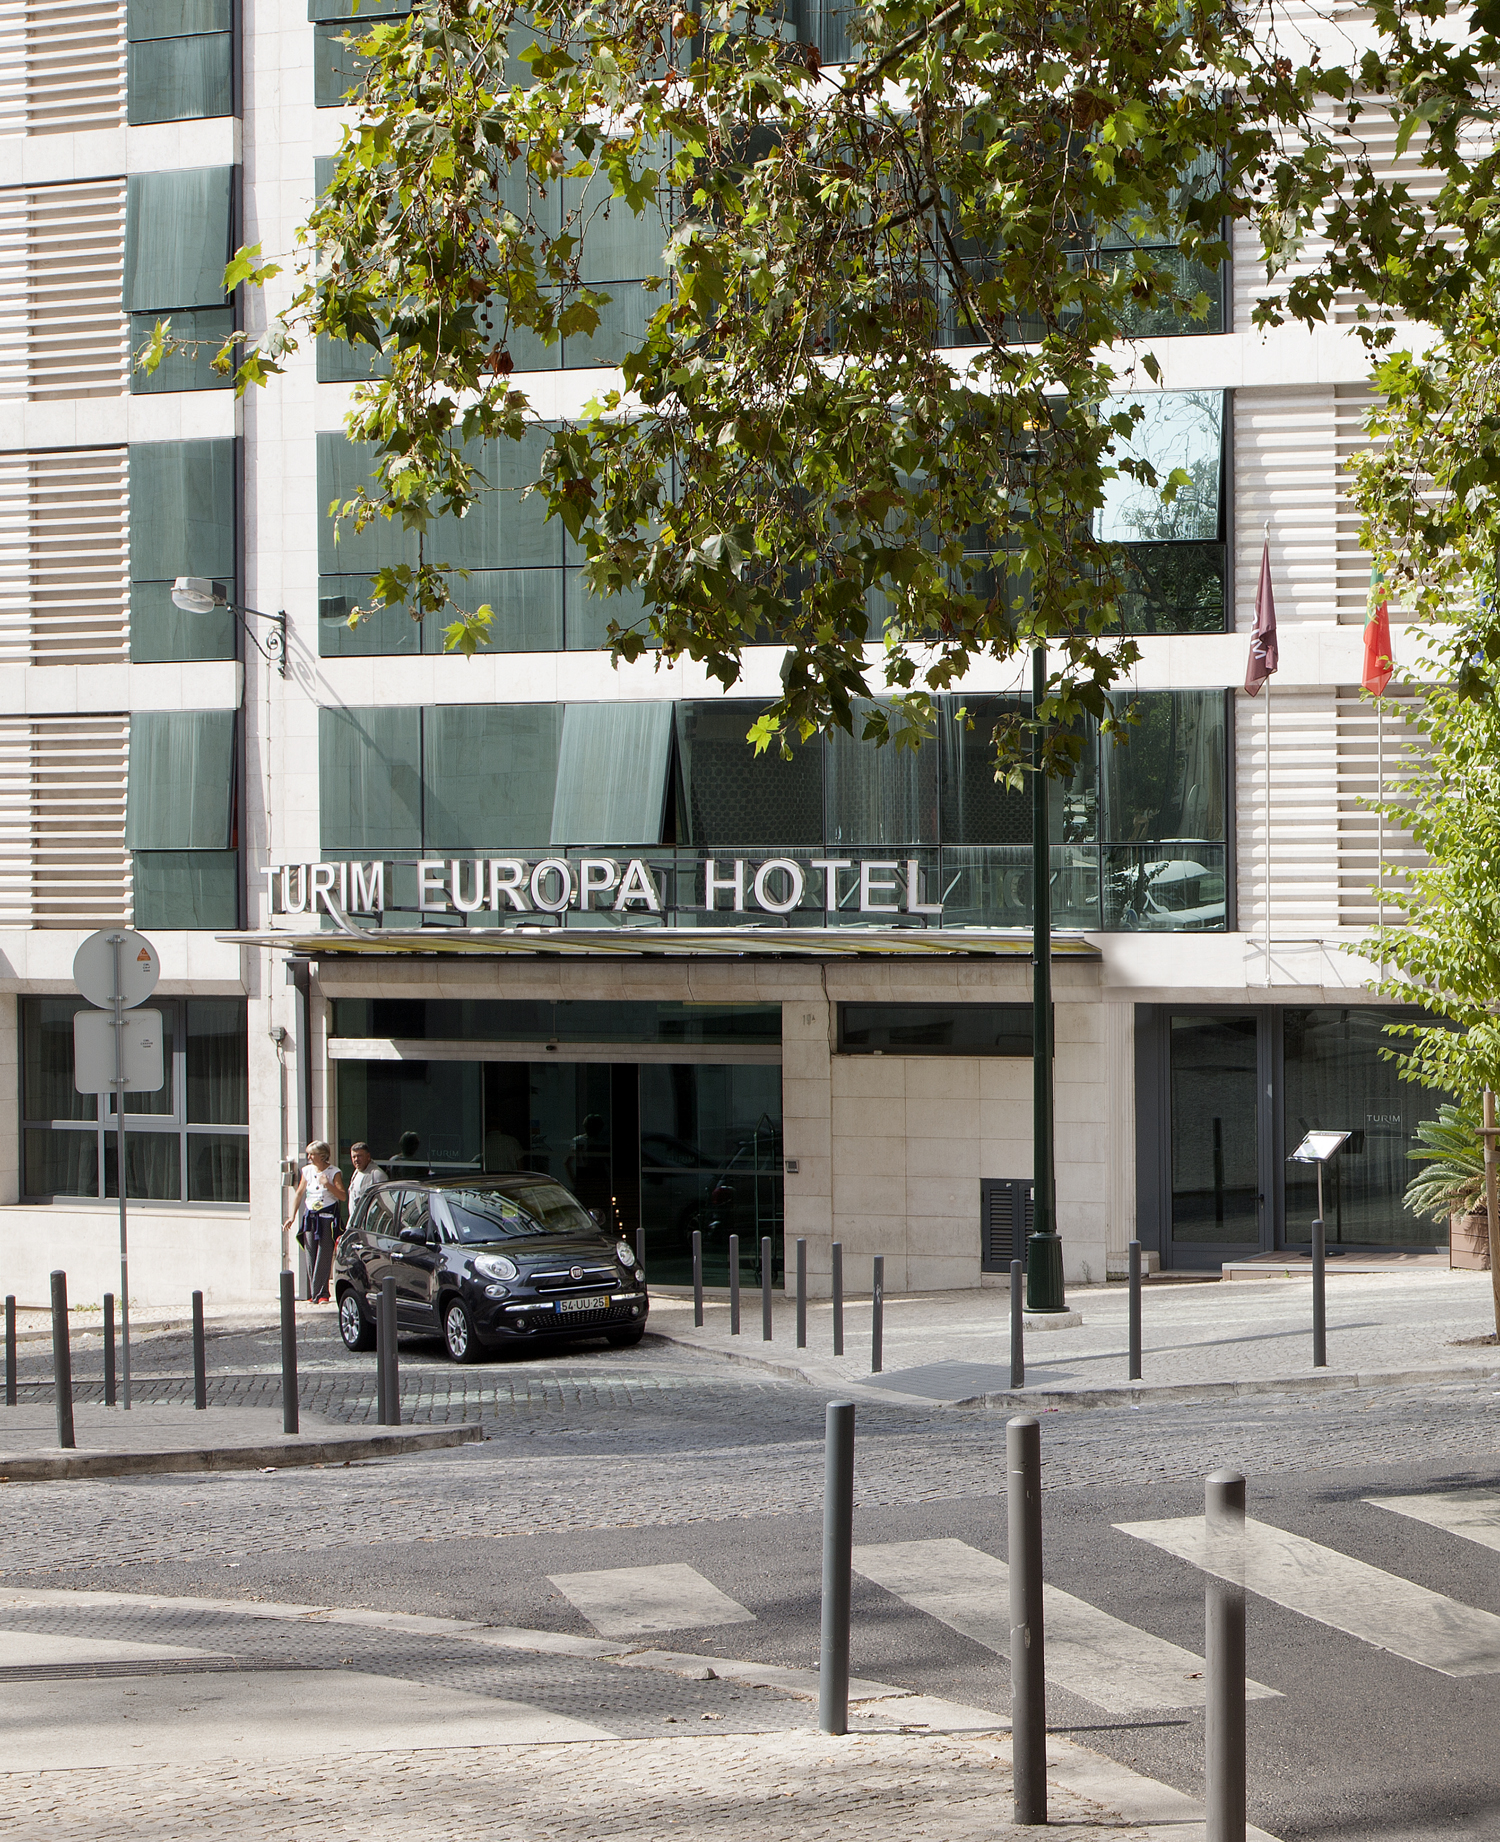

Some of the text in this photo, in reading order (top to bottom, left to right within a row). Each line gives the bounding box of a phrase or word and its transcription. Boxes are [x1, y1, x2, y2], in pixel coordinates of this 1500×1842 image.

[260, 858, 943, 940] TURIM EUROPA HOTEL
[1366, 1114, 1401, 1125] TURIM
[430, 1149, 459, 1159] TURIM
